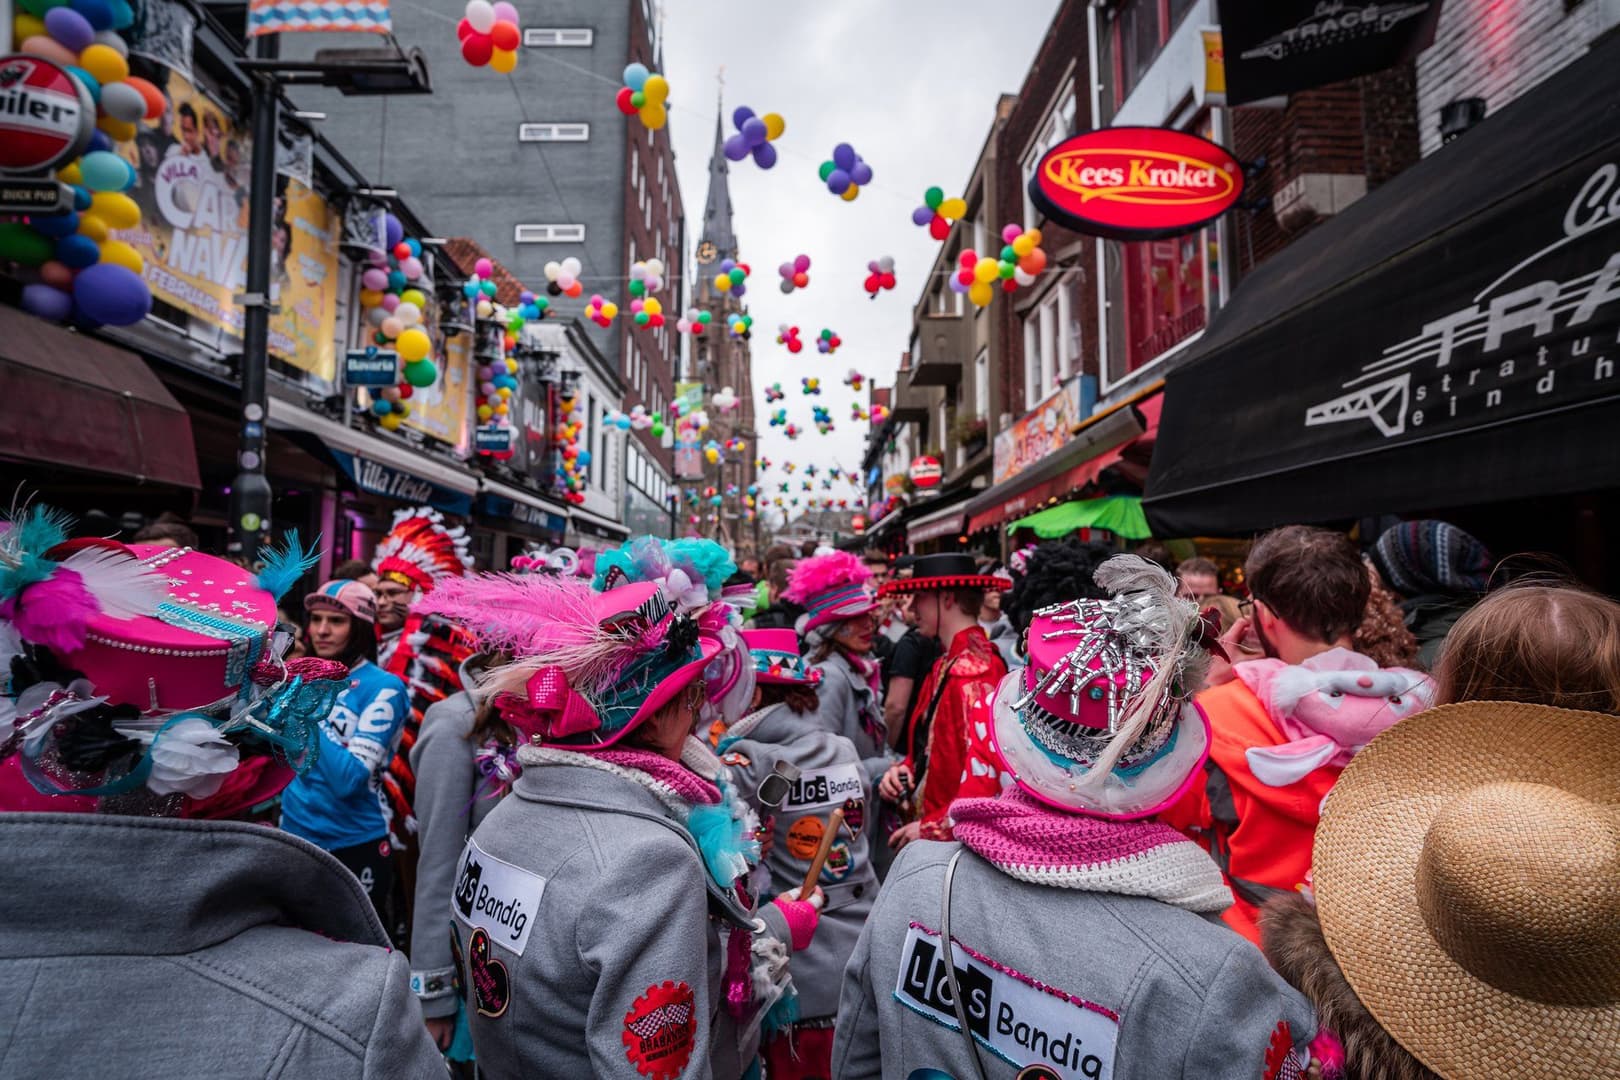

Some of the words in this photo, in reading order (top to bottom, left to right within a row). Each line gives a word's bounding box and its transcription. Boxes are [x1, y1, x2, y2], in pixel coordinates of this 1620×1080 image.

[161, 164, 199, 183] VILLA
[1057, 158, 1124, 188] Kees
[1128, 160, 1216, 188] Kroket
[33, 189, 57, 203] PUB
[475, 884, 528, 941] Bandig
[996, 1001, 1104, 1080] Bandig
